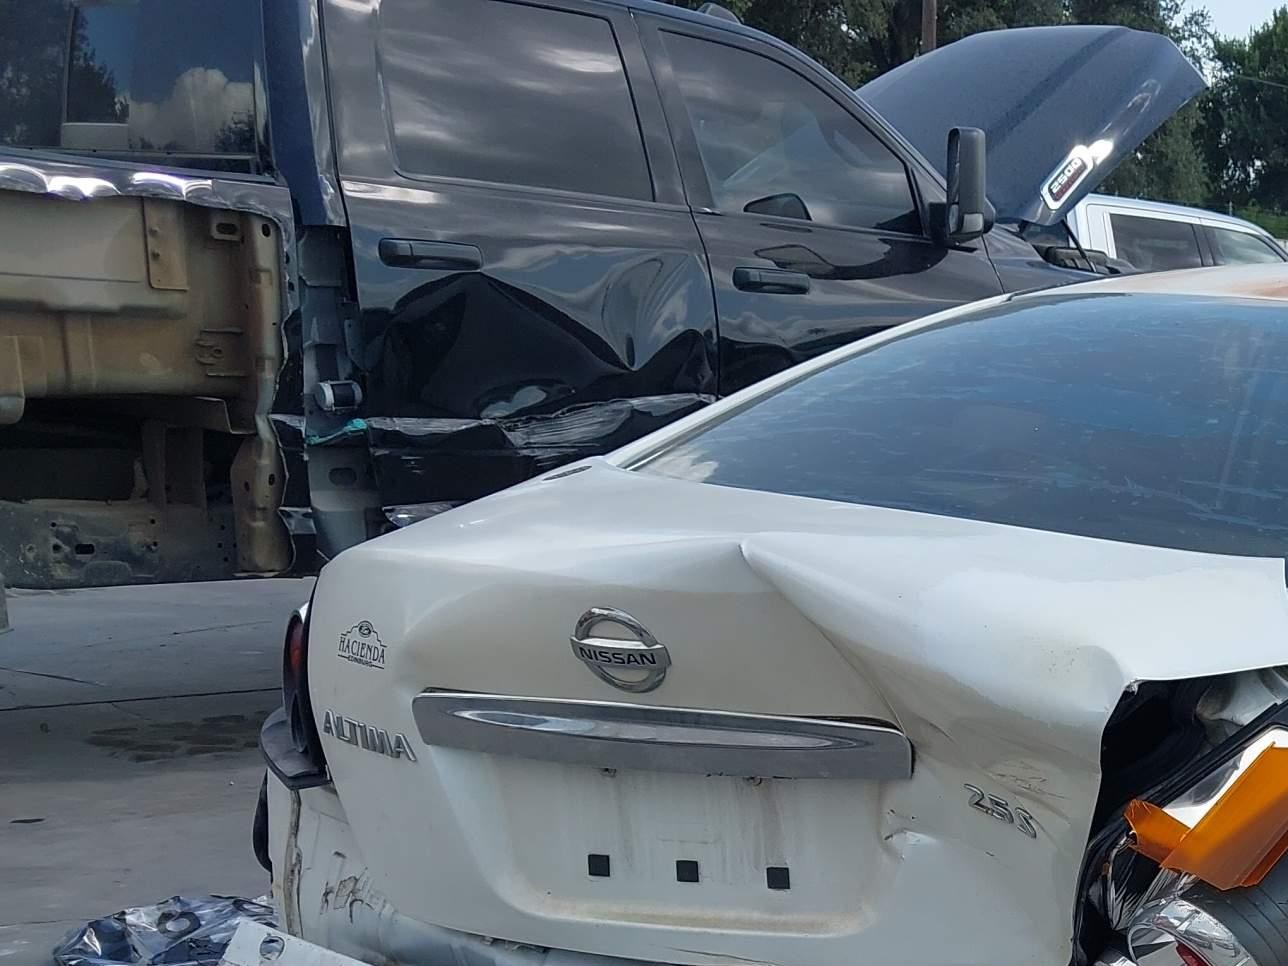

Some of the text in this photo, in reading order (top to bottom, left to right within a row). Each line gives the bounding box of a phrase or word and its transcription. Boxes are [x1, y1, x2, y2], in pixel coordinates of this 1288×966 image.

[1050, 157, 1083, 194] 2500
[338, 635, 386, 665] HACIENDA
[579, 646, 657, 665] NISSAN
[323, 709, 417, 762] ALTIMA
[1014, 805, 1038, 839] S
